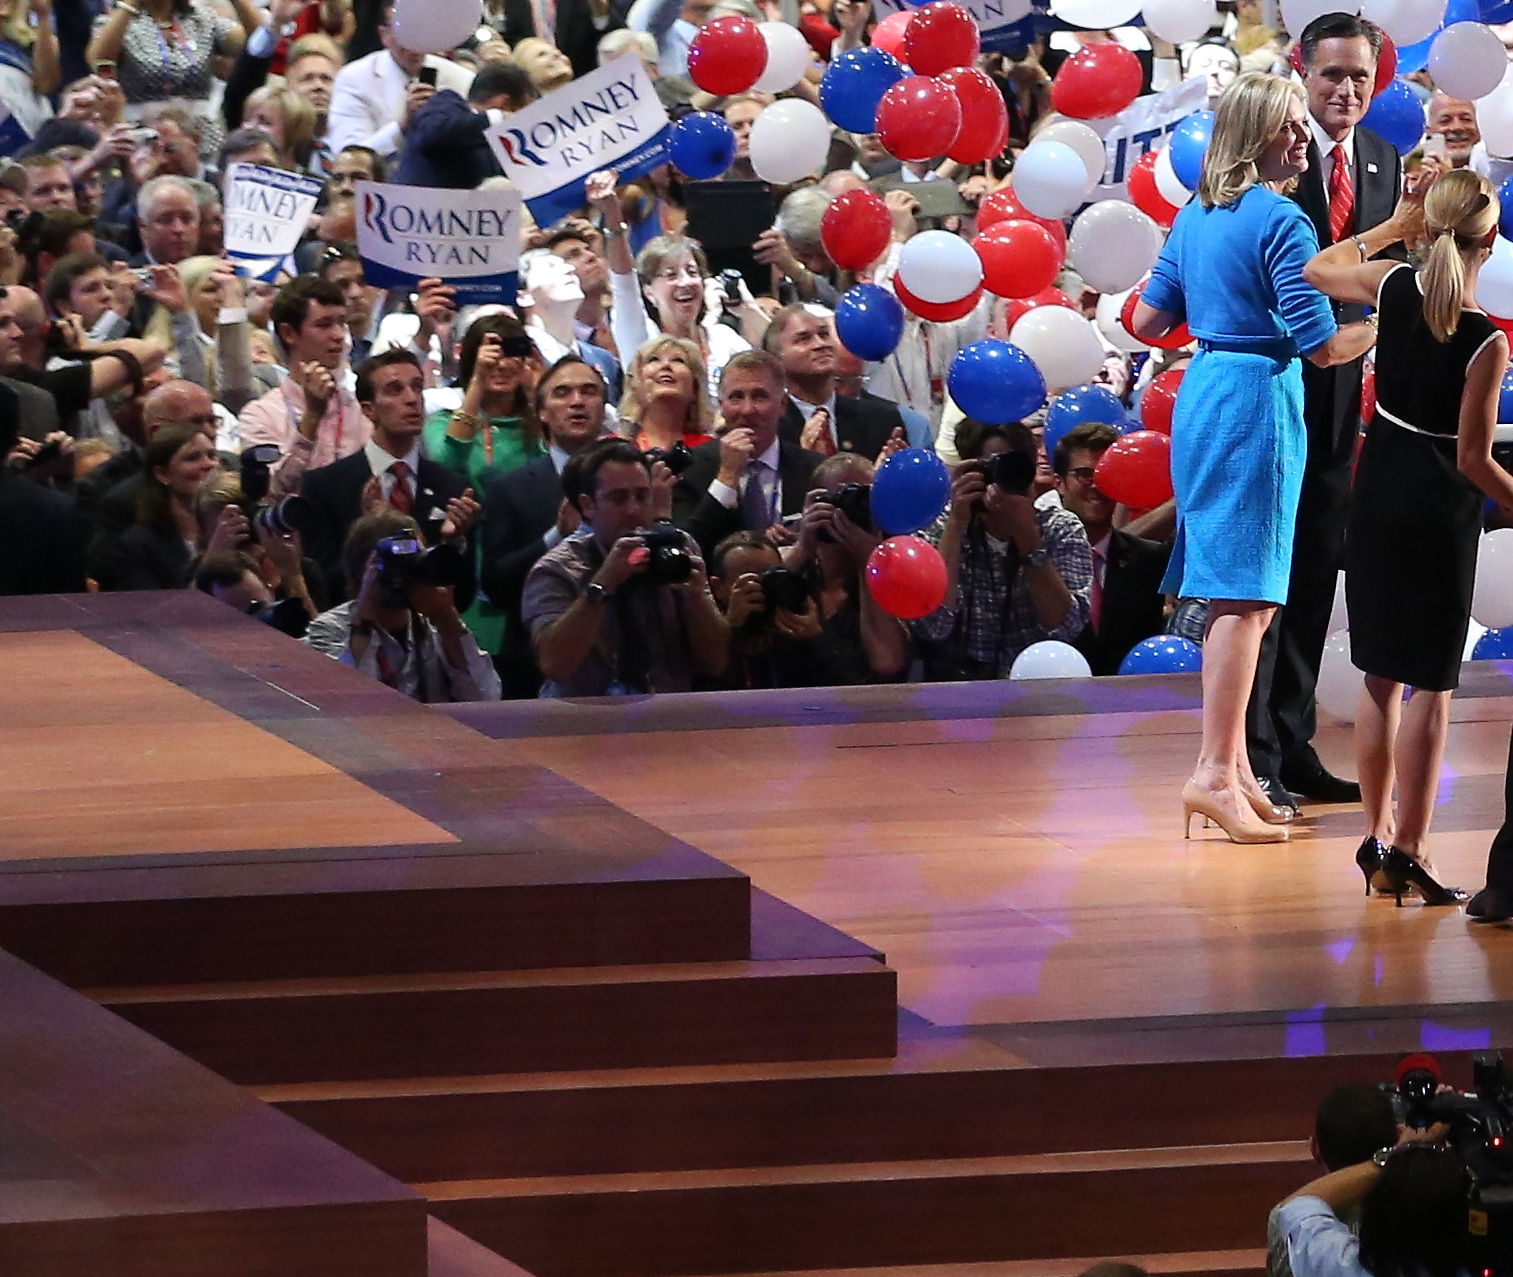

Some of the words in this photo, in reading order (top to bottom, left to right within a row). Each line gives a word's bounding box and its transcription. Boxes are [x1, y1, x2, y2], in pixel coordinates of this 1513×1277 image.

[498, 73, 640, 166] ROMNEY
[560, 115, 640, 167] RYAN
[228, 183, 307, 220] MNEY
[365, 192, 513, 244] ROMNEY
[405, 241, 490, 265] RYAN
